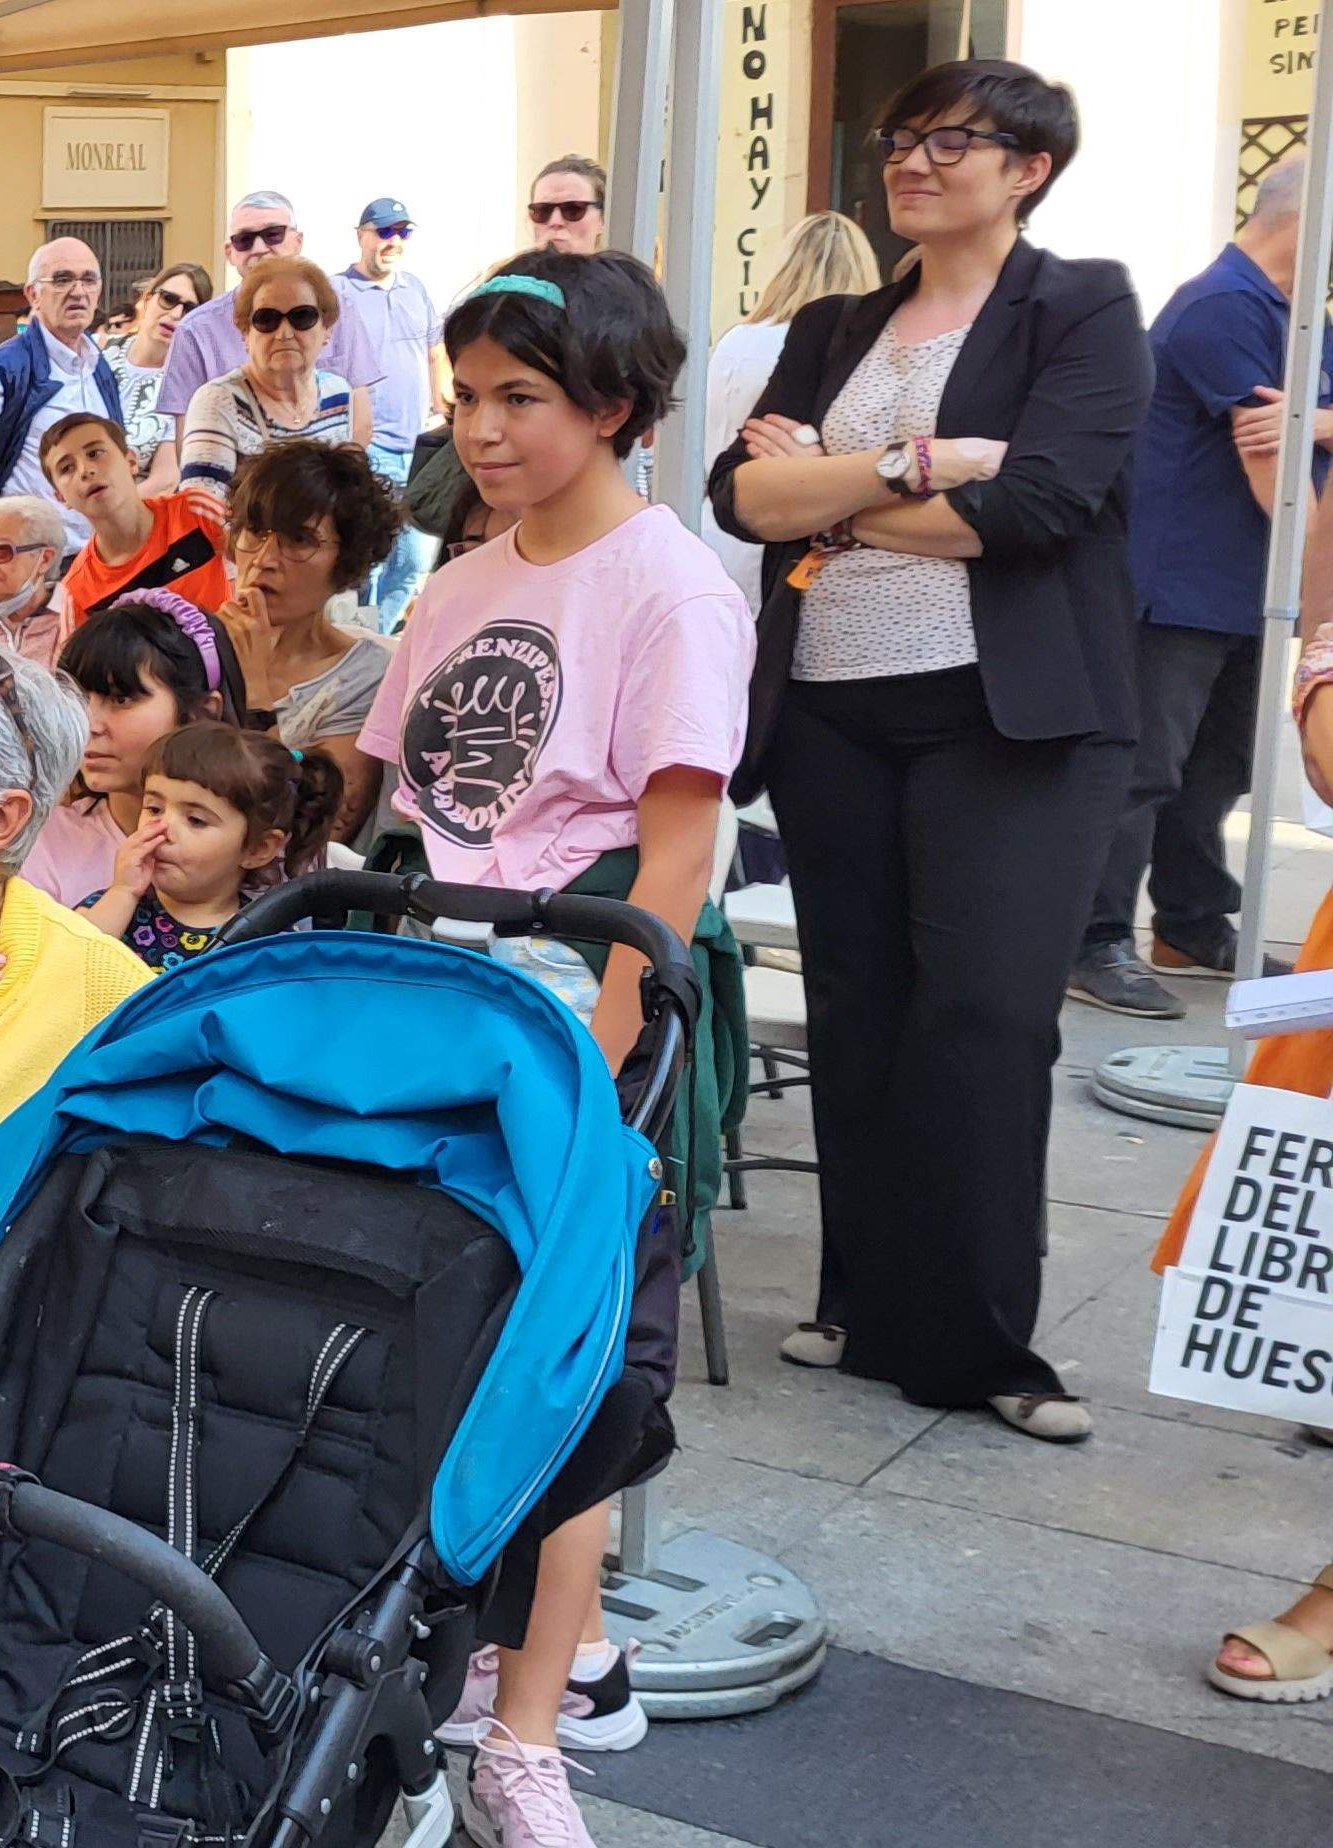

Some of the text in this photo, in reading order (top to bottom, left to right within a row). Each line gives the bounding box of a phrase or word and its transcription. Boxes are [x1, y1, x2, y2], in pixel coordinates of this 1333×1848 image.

[65, 141, 148, 172] MONREAL
[1223, 1176, 1320, 1239] DEL
[1194, 1275, 1271, 1331] DE
[1180, 1323, 1333, 1395] HUES
